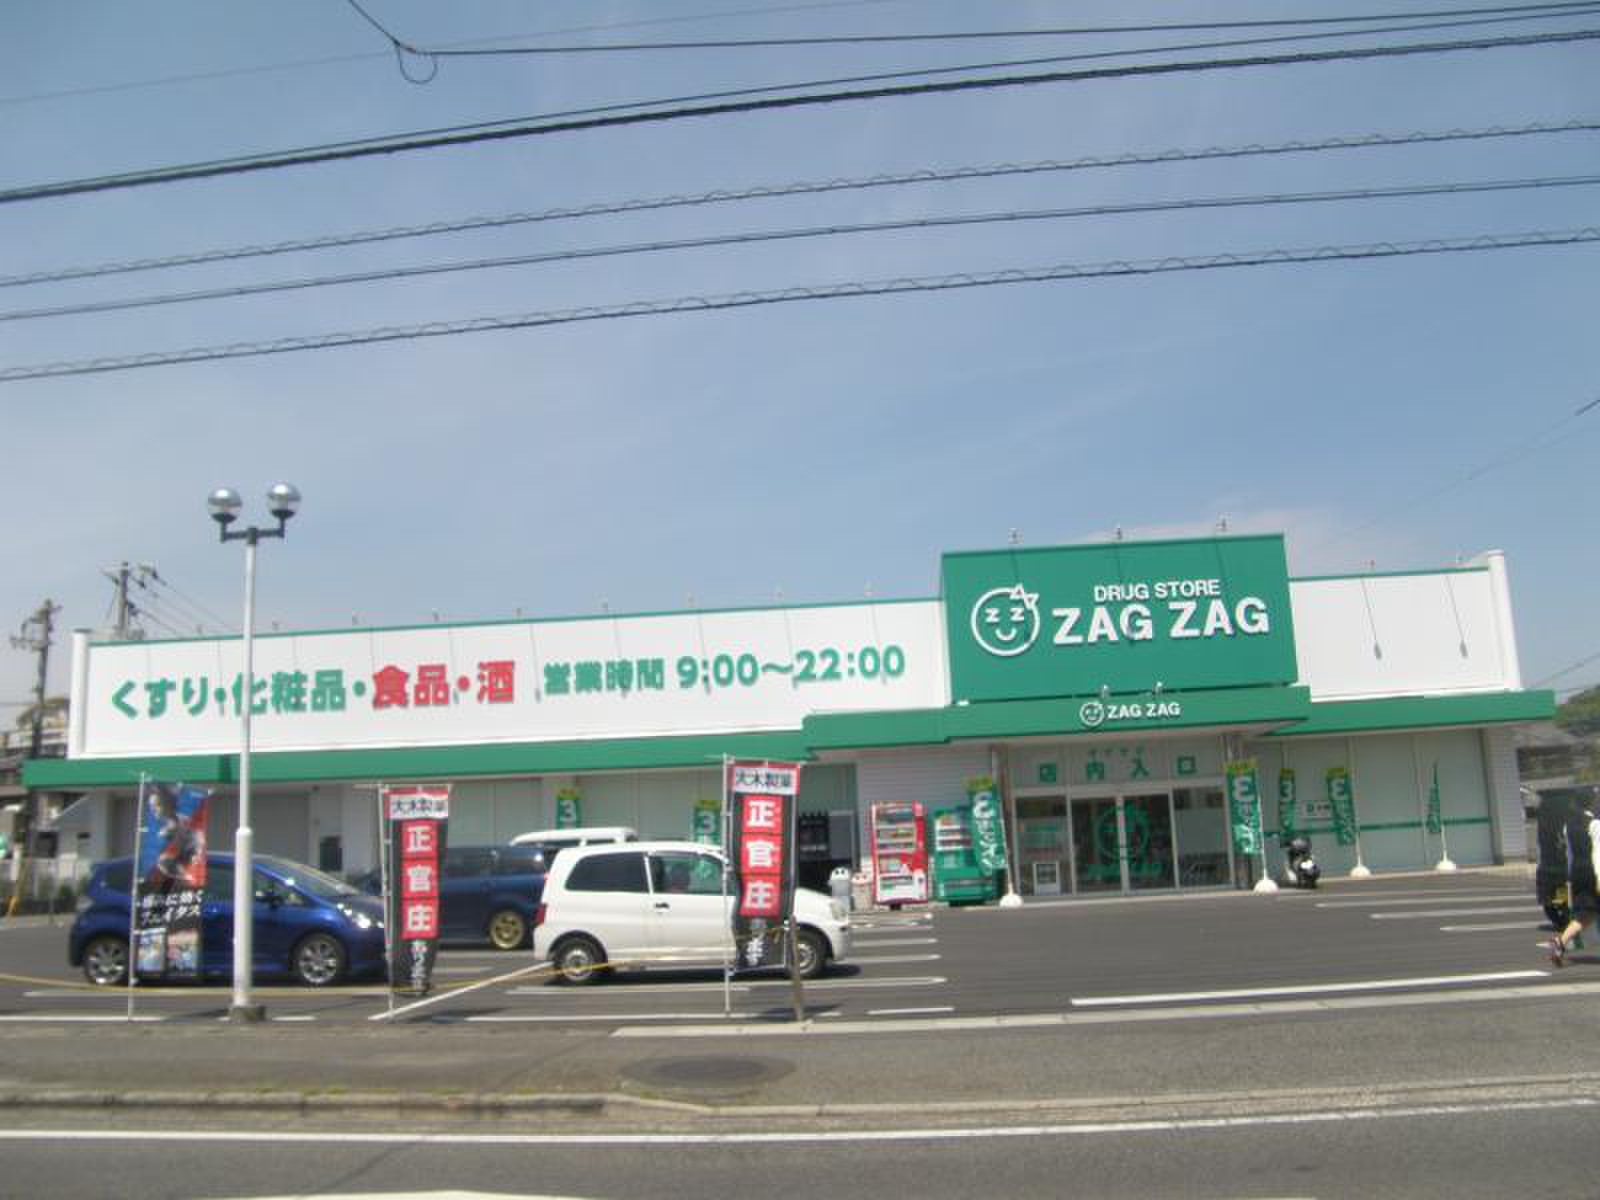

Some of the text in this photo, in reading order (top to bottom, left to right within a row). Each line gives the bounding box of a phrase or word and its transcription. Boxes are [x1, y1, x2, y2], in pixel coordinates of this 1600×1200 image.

[1094, 579, 1220, 602] DRUG STORE
[1052, 597, 1270, 645] ZAG ZAG
[543, 658, 665, 695] 営業時間
[1107, 701, 1181, 719] ZAG ZAG
[743, 800, 775, 910] 正官庄
[406, 825, 433, 931] 正官庄
